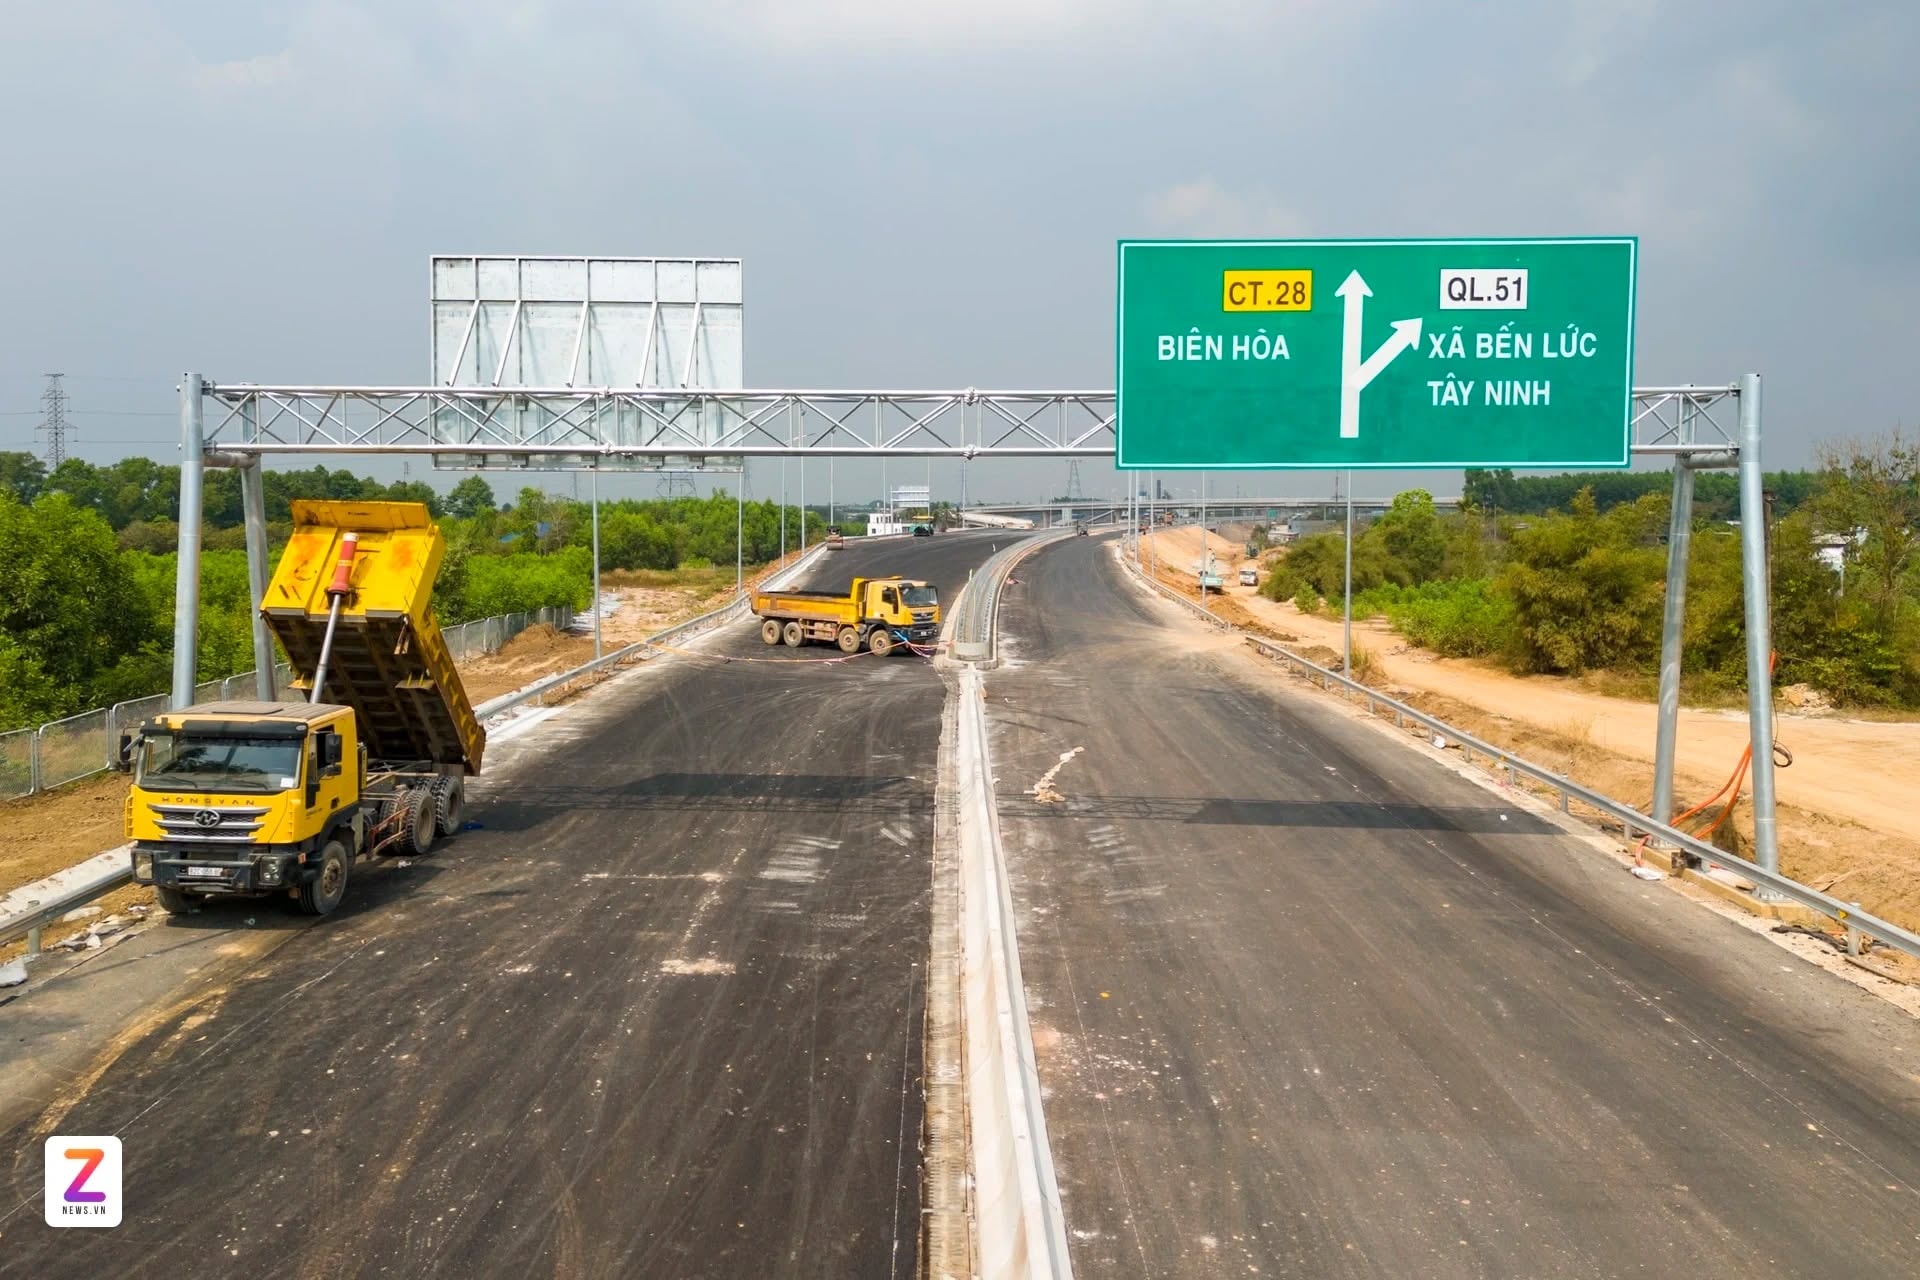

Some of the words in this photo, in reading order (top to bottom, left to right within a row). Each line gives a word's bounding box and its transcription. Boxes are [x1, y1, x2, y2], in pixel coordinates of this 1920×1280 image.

[1229, 281, 1306, 305] CT.28
[1447, 277, 1522, 302] QL.51
[1158, 327, 1223, 361] BIÊN
[1232, 328, 1290, 360] HÒA
[1428, 325, 1466, 359] XÃ
[1476, 321, 1532, 359] BẾN
[1543, 323, 1597, 359] LỨC
[1427, 372, 1475, 406] TÂY
[1485, 380, 1551, 406] NINH
